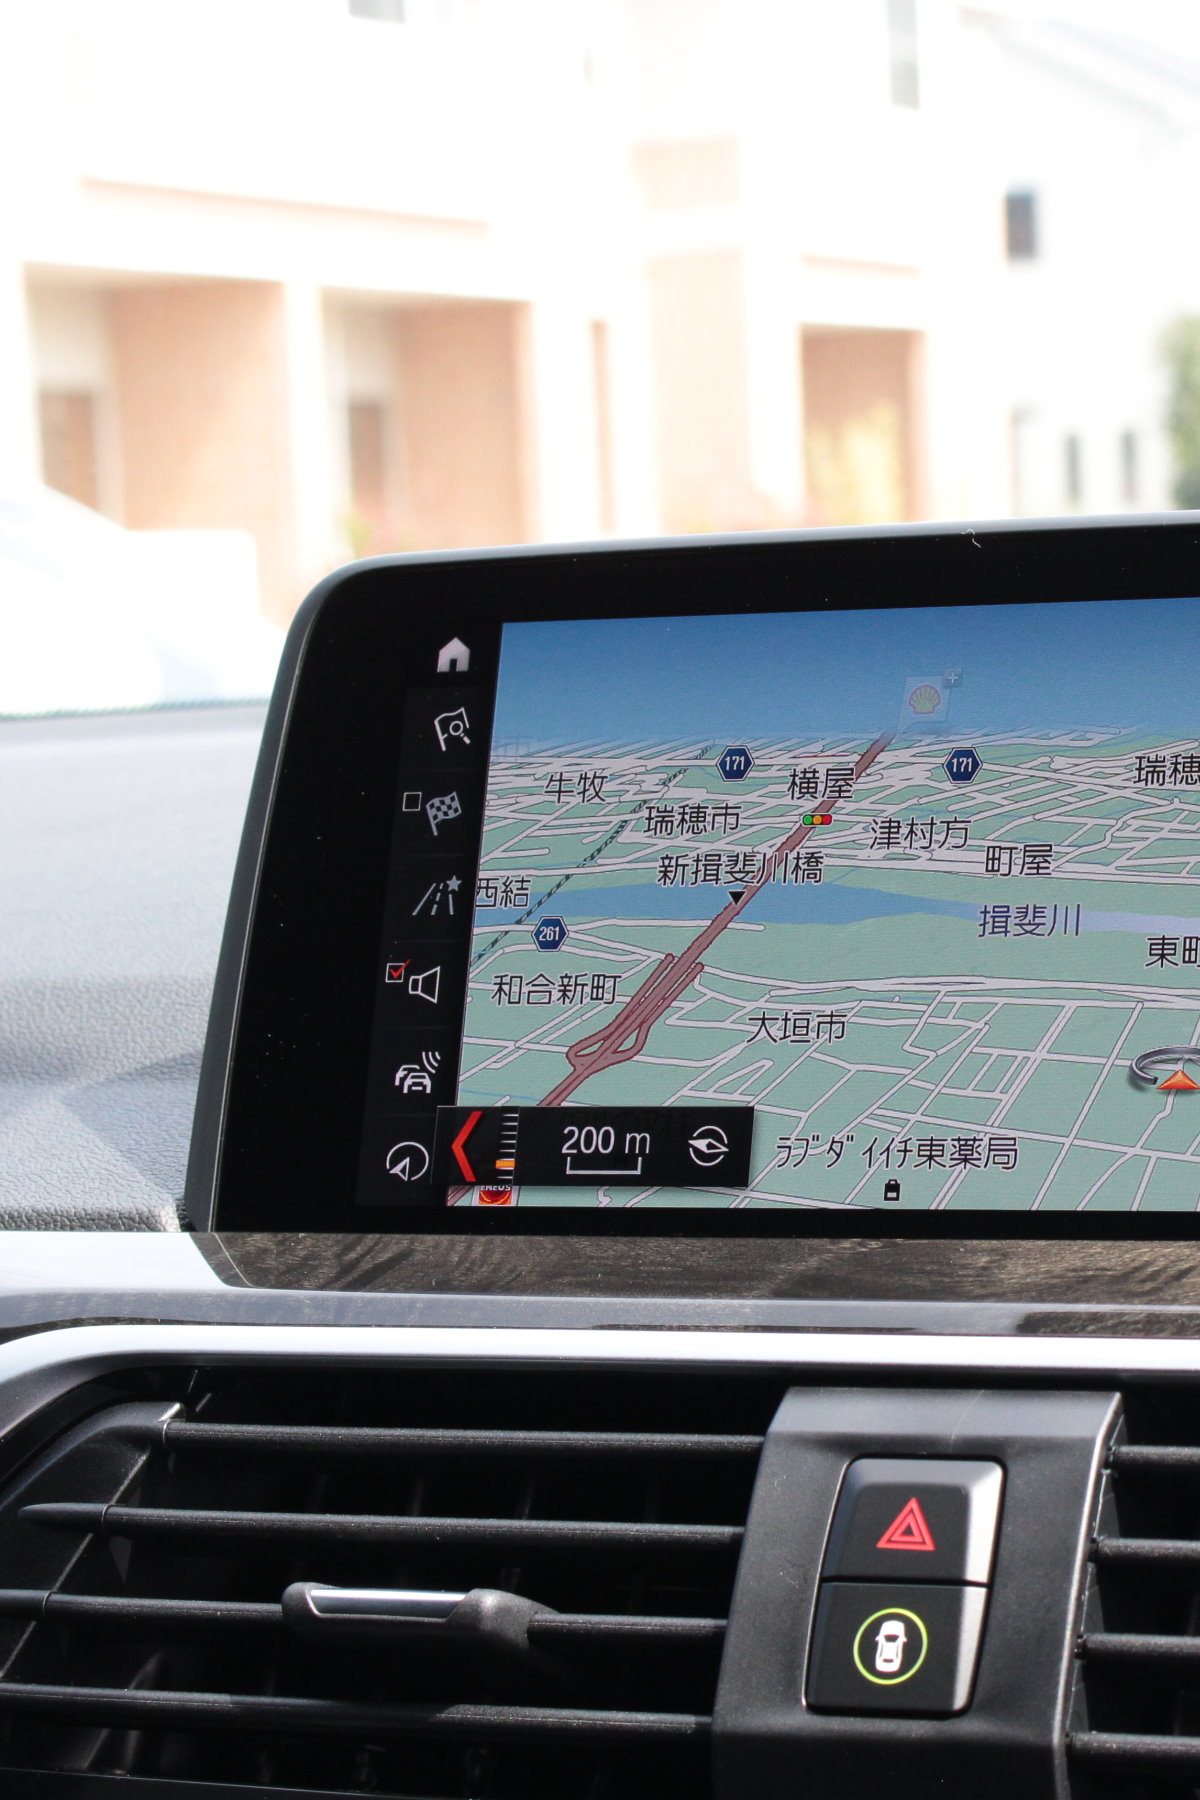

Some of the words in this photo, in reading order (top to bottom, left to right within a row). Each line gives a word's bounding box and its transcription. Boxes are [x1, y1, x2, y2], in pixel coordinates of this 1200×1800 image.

[724, 755, 746, 772] 171
[951, 757, 973, 774] 171
[544, 772, 608, 804] 牛牧
[788, 767, 856, 800] 横屋
[643, 803, 742, 837] 瑞穂市
[869, 816, 972, 850] 津村方
[656, 850, 825, 887] 新揖斐川橋
[984, 844, 1053, 878] 町屋
[475, 876, 532, 909] 西結
[539, 927, 560, 942] 261
[978, 903, 1082, 938] 揖斐川
[490, 972, 622, 1006] 和合新町
[746, 1010, 848, 1045] 大垣市
[561, 1126, 615, 1154] 200
[624, 1132, 650, 1154] m
